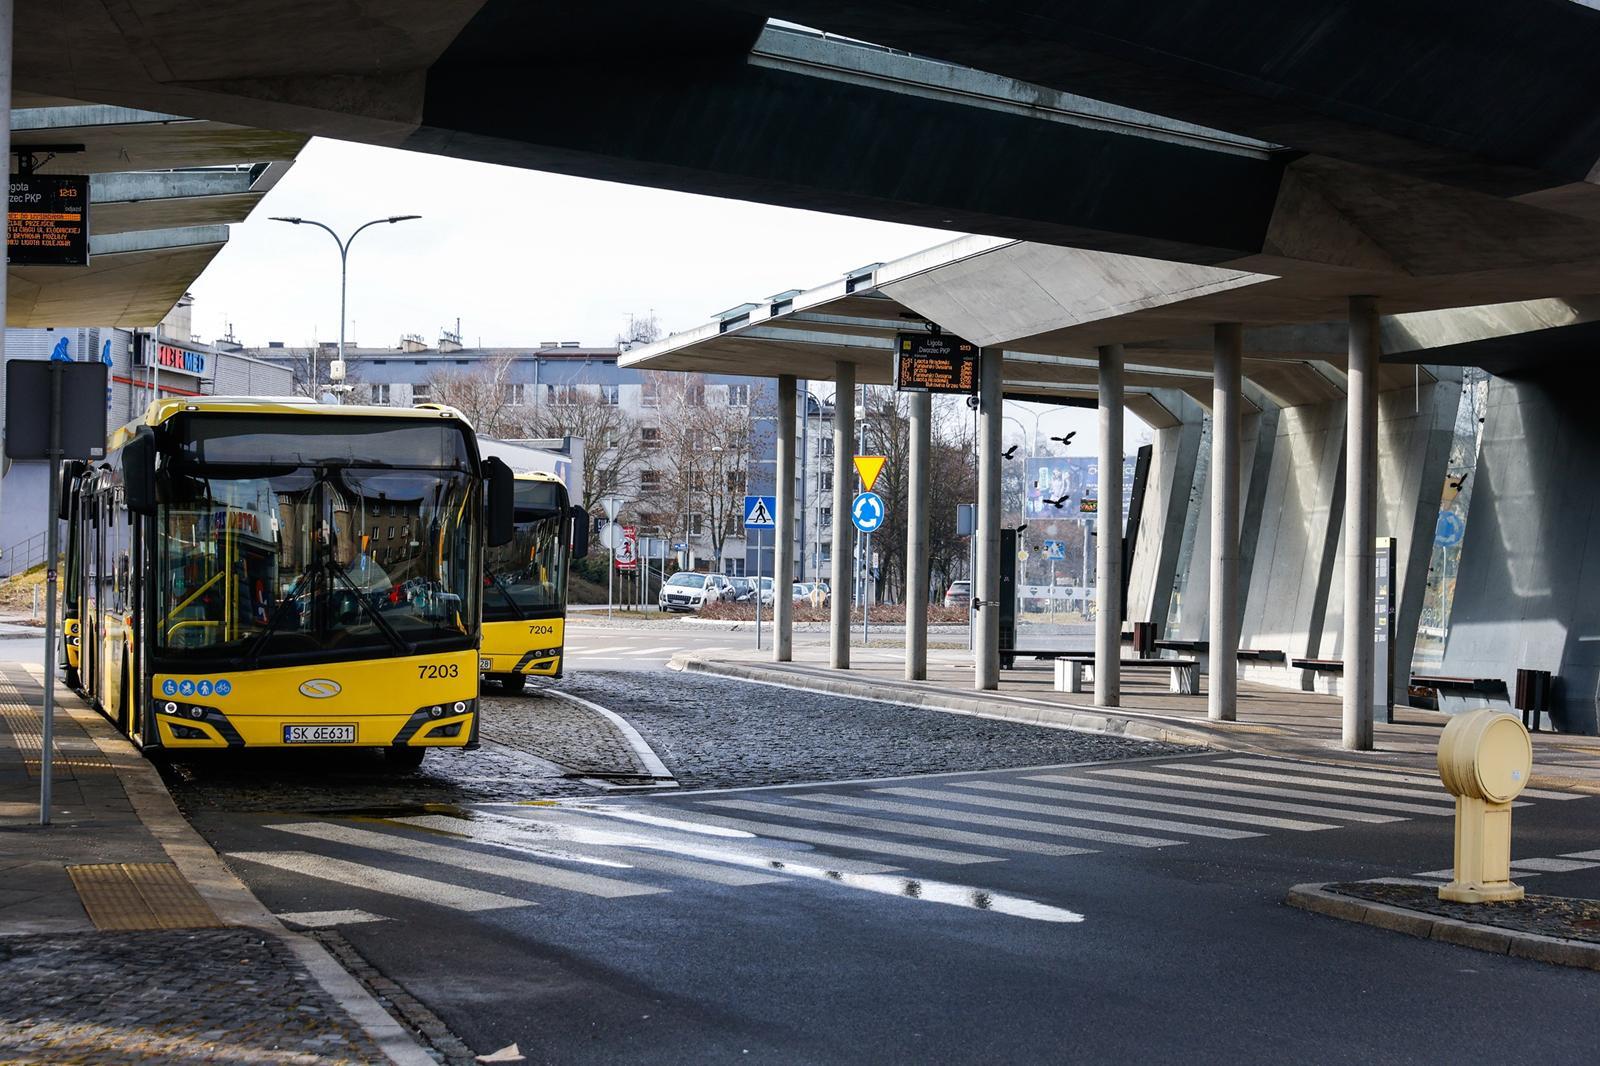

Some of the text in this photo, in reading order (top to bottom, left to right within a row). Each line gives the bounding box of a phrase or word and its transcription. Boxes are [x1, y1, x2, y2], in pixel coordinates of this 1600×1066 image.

[59, 188, 78, 197] 12:13
[24, 193, 42, 203] PKP
[926, 339, 944, 348] Ligota
[529, 626, 553, 635] 7204
[480, 660, 489, 669] 28
[418, 664, 459, 679] 7203
[293, 727, 309, 740] SK
[313, 727, 350, 740] 6E631
